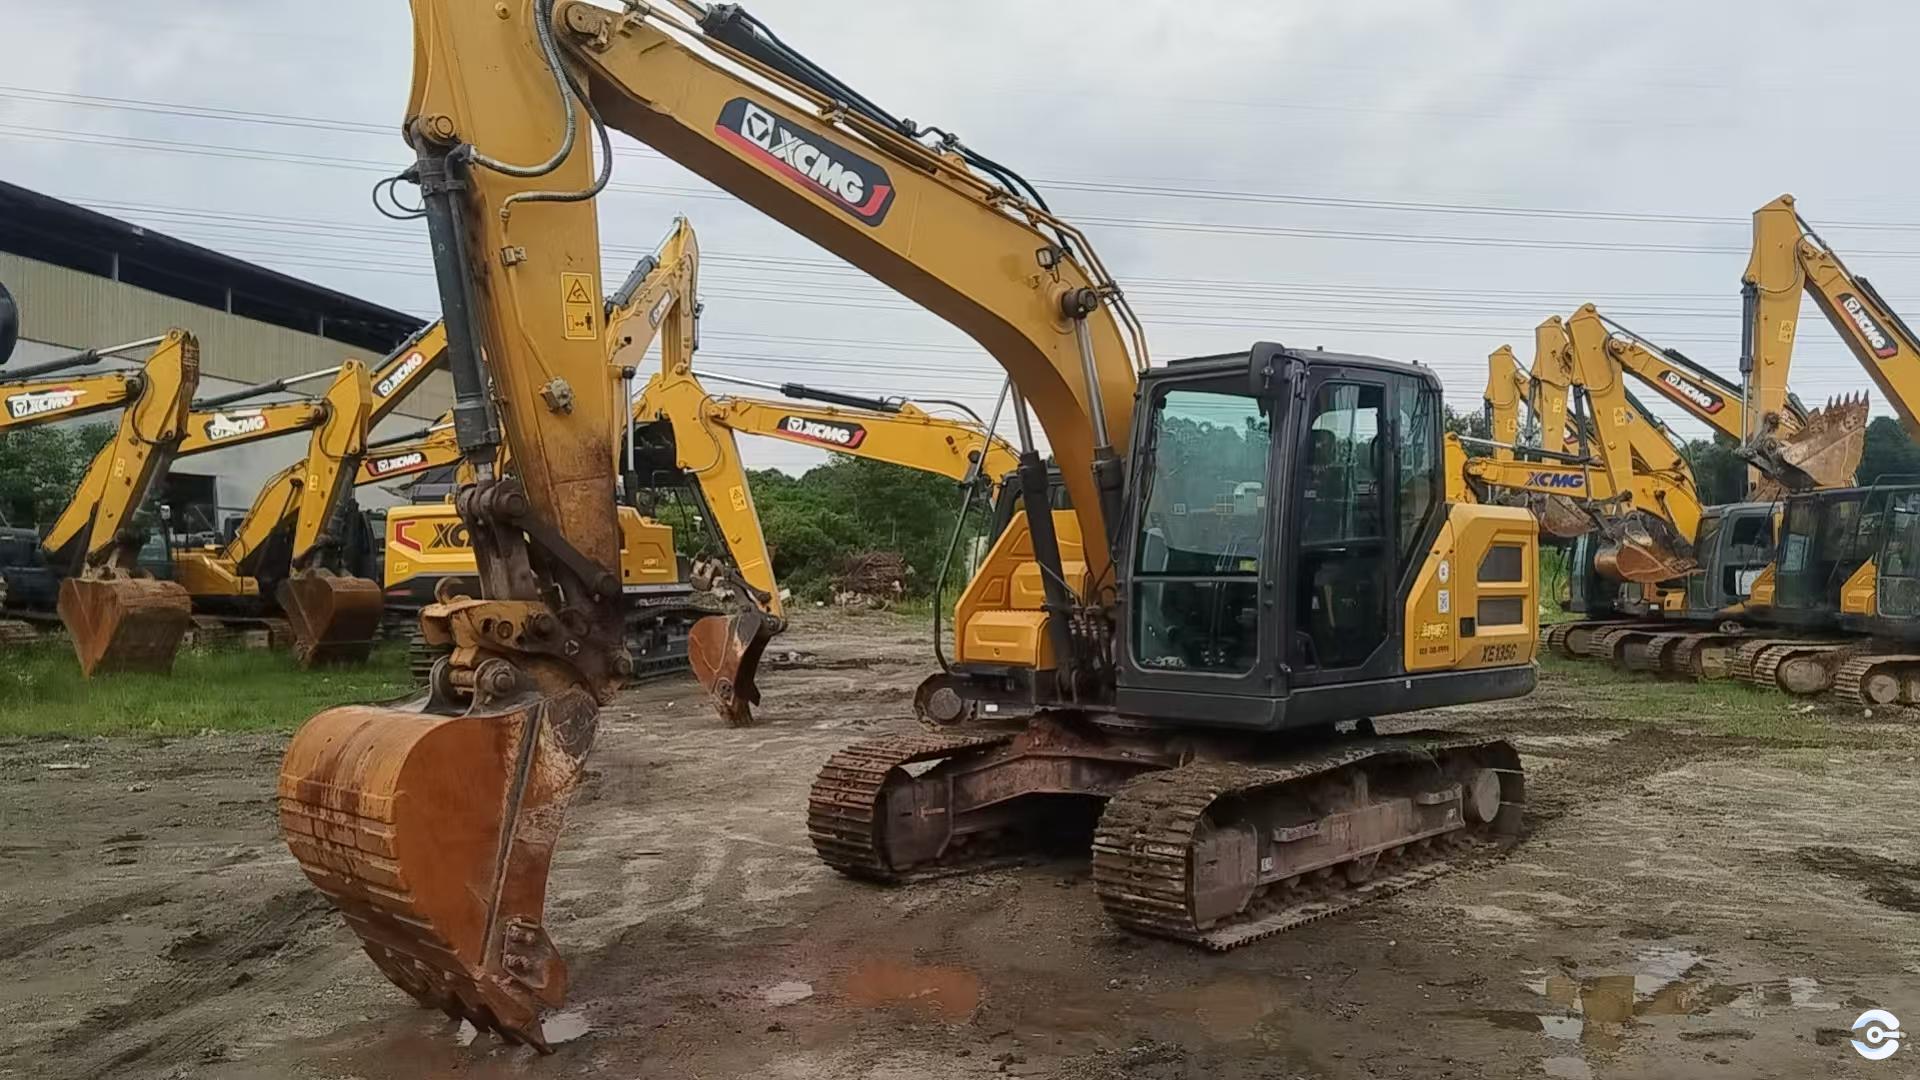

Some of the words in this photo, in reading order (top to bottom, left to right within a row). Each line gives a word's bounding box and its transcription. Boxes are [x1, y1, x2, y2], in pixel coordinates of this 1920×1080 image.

[768, 127, 864, 204] XCMG
[802, 421, 850, 444] XCMG
[1524, 471, 1584, 488] XCMG
[427, 523, 472, 549] XC
